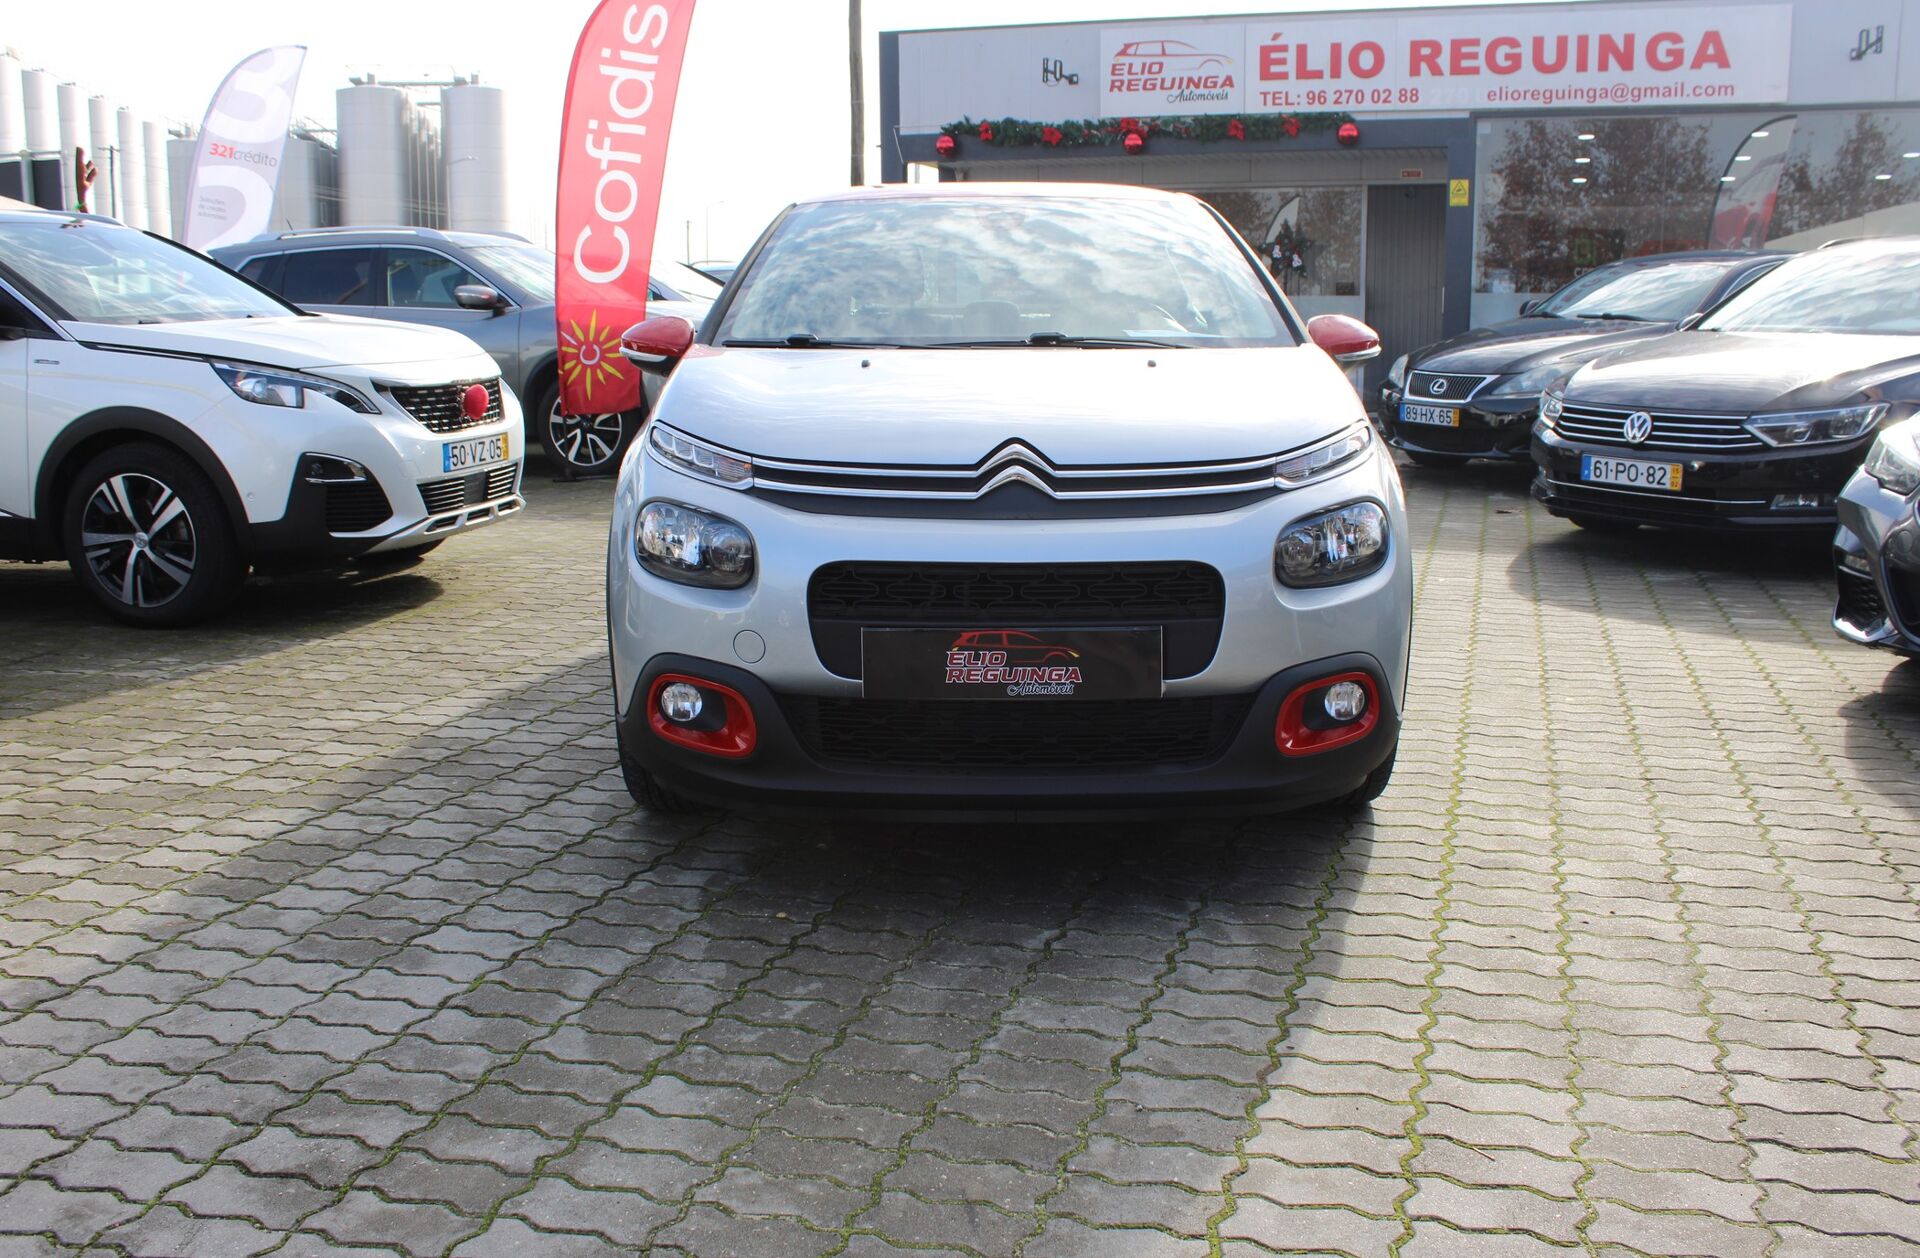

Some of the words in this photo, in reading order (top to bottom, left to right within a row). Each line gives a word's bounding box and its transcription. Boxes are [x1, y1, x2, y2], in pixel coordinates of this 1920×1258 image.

[1259, 32, 1386, 81] ÉLIO
[1409, 30, 1732, 77] REGUINGA
[1109, 75, 1235, 93] REGUINGA
[1487, 82, 1735, 104] elioreguinga@gmail.com
[1166, 88, 1229, 104] Automóveis
[1259, 91, 1301, 106] TEL:
[1306, 90, 1327, 105] 96
[1333, 89, 1365, 105] 270
[1371, 88, 1392, 104] 02
[1398, 88, 1419, 103] 88
[573, 4, 669, 284] Cofidis
[945, 667, 1082, 683] REGUINGA
[1007, 681, 1074, 696] Automóveis
